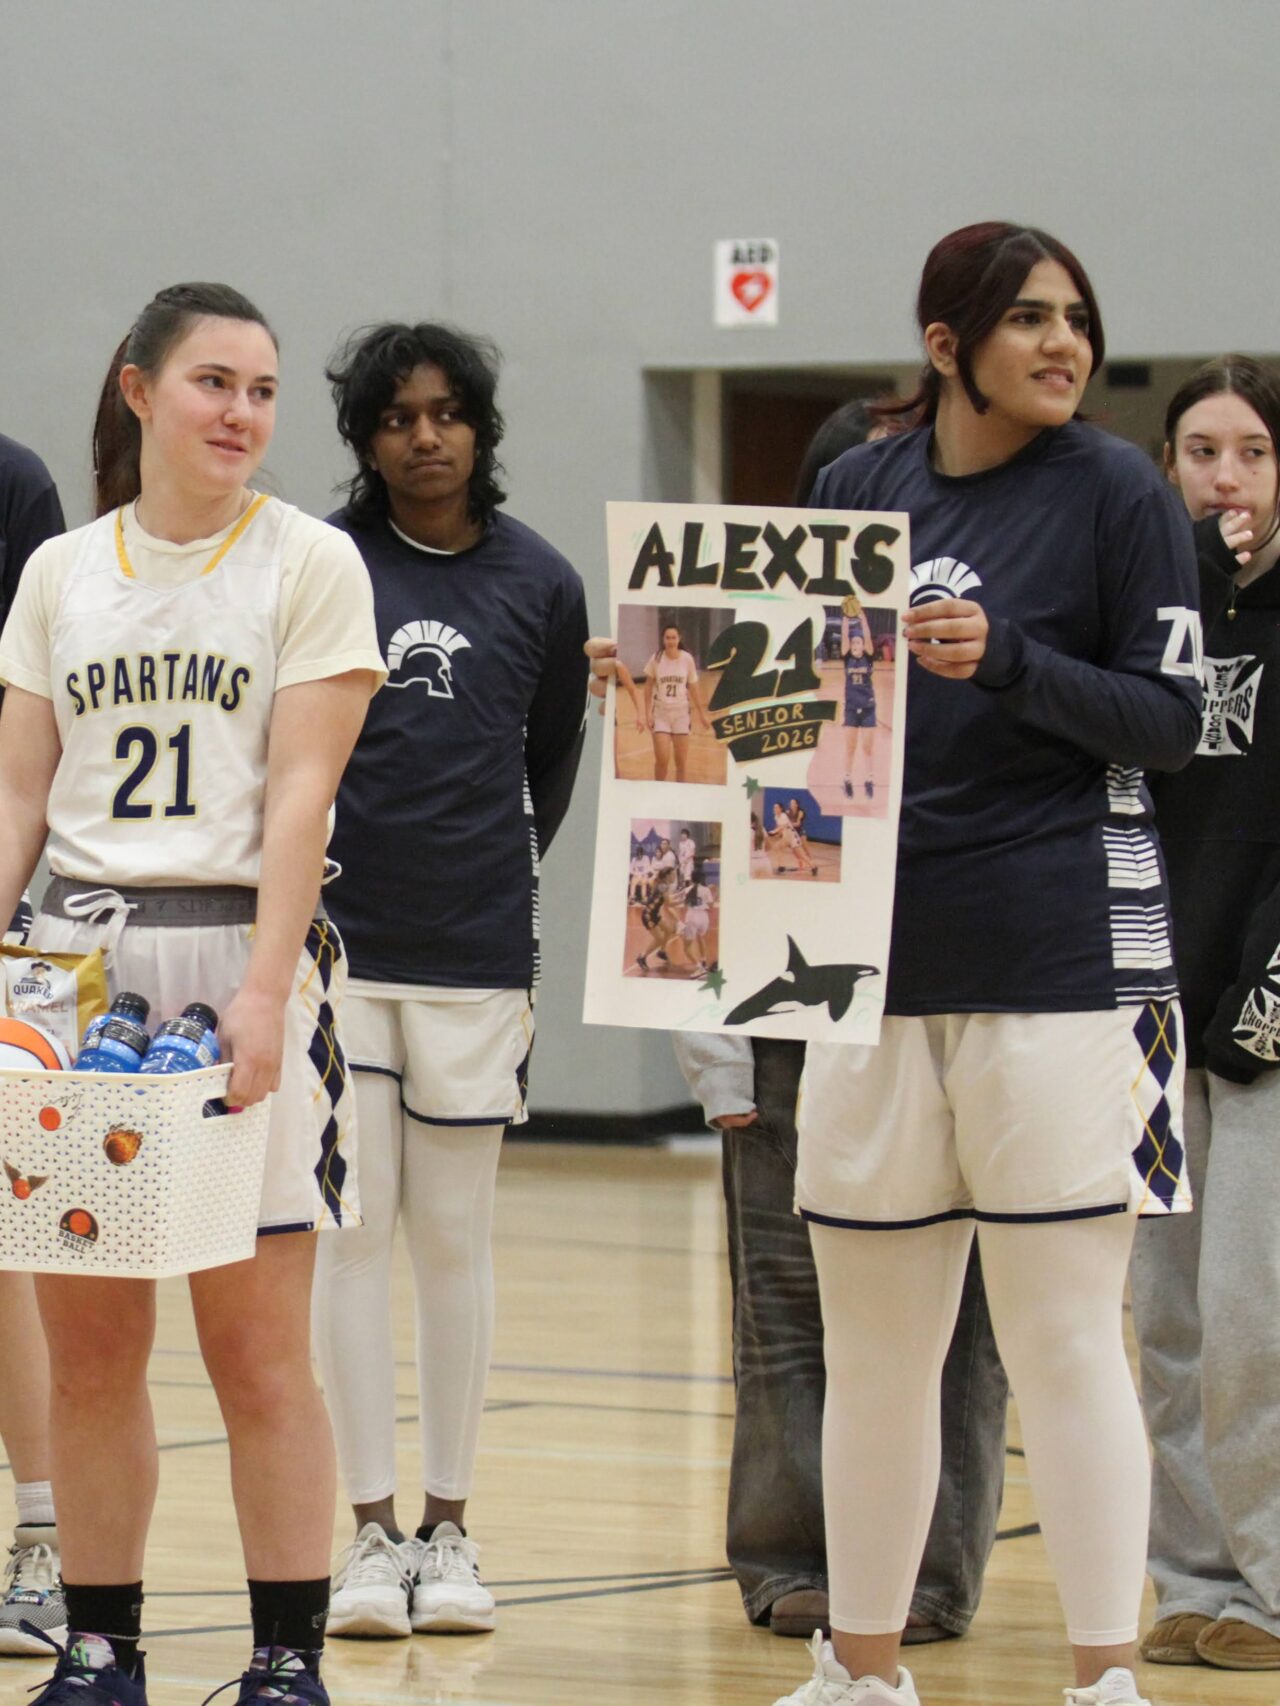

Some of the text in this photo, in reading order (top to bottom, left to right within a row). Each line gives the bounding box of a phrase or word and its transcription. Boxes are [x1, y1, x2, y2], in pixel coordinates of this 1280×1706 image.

[730, 243, 773, 264] AED
[628, 521, 901, 596] ALEXIS
[707, 616, 821, 711] 21
[66, 653, 250, 716] SPARTANS
[666, 684, 677, 697] 21
[1202, 684, 1253, 722] PPERS
[722, 703, 804, 735] SENIOR
[761, 728, 815, 753] 2026
[112, 724, 196, 819] 21
[17, 1001, 68, 1013] RAMEL
[58, 1229, 95, 1249] BASKET
[62, 1240, 86, 1254] BALL
